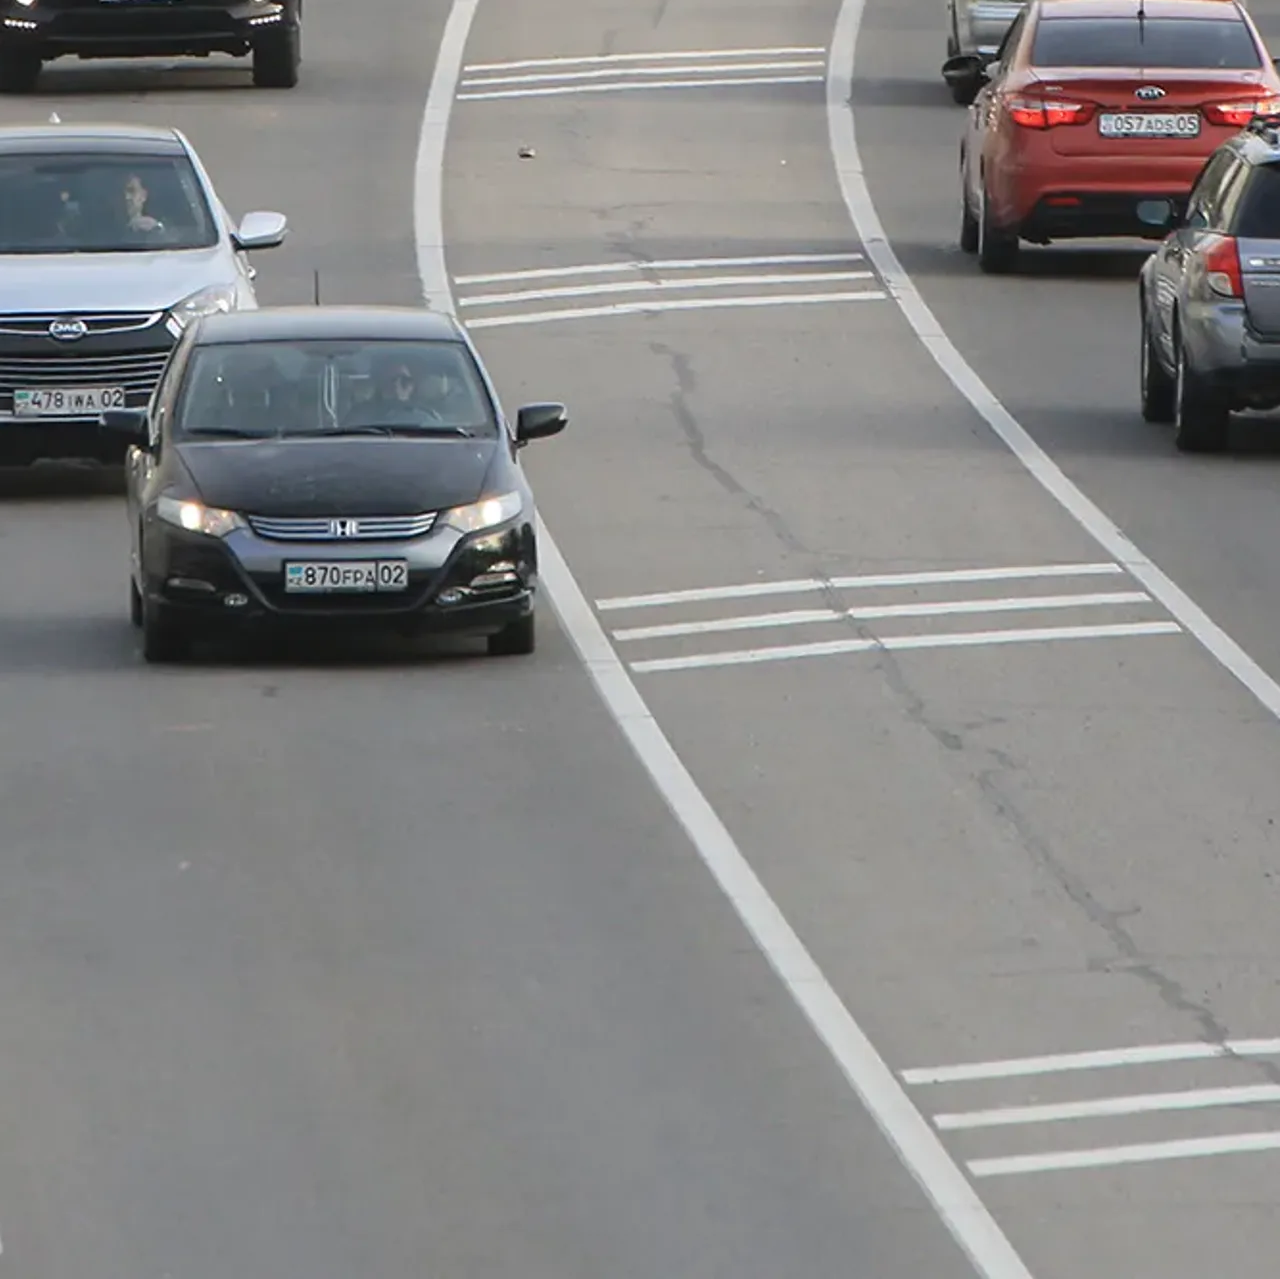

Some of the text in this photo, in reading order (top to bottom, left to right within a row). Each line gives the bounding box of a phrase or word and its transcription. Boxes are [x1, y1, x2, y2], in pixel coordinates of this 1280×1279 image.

[1114, 116, 1144, 131] 057
[1177, 116, 1197, 131] 05
[31, 391, 64, 410] 478
[101, 389, 124, 408] 02
[305, 566, 341, 586] 870
[342, 569, 375, 584] FPA
[380, 565, 405, 585] 02
